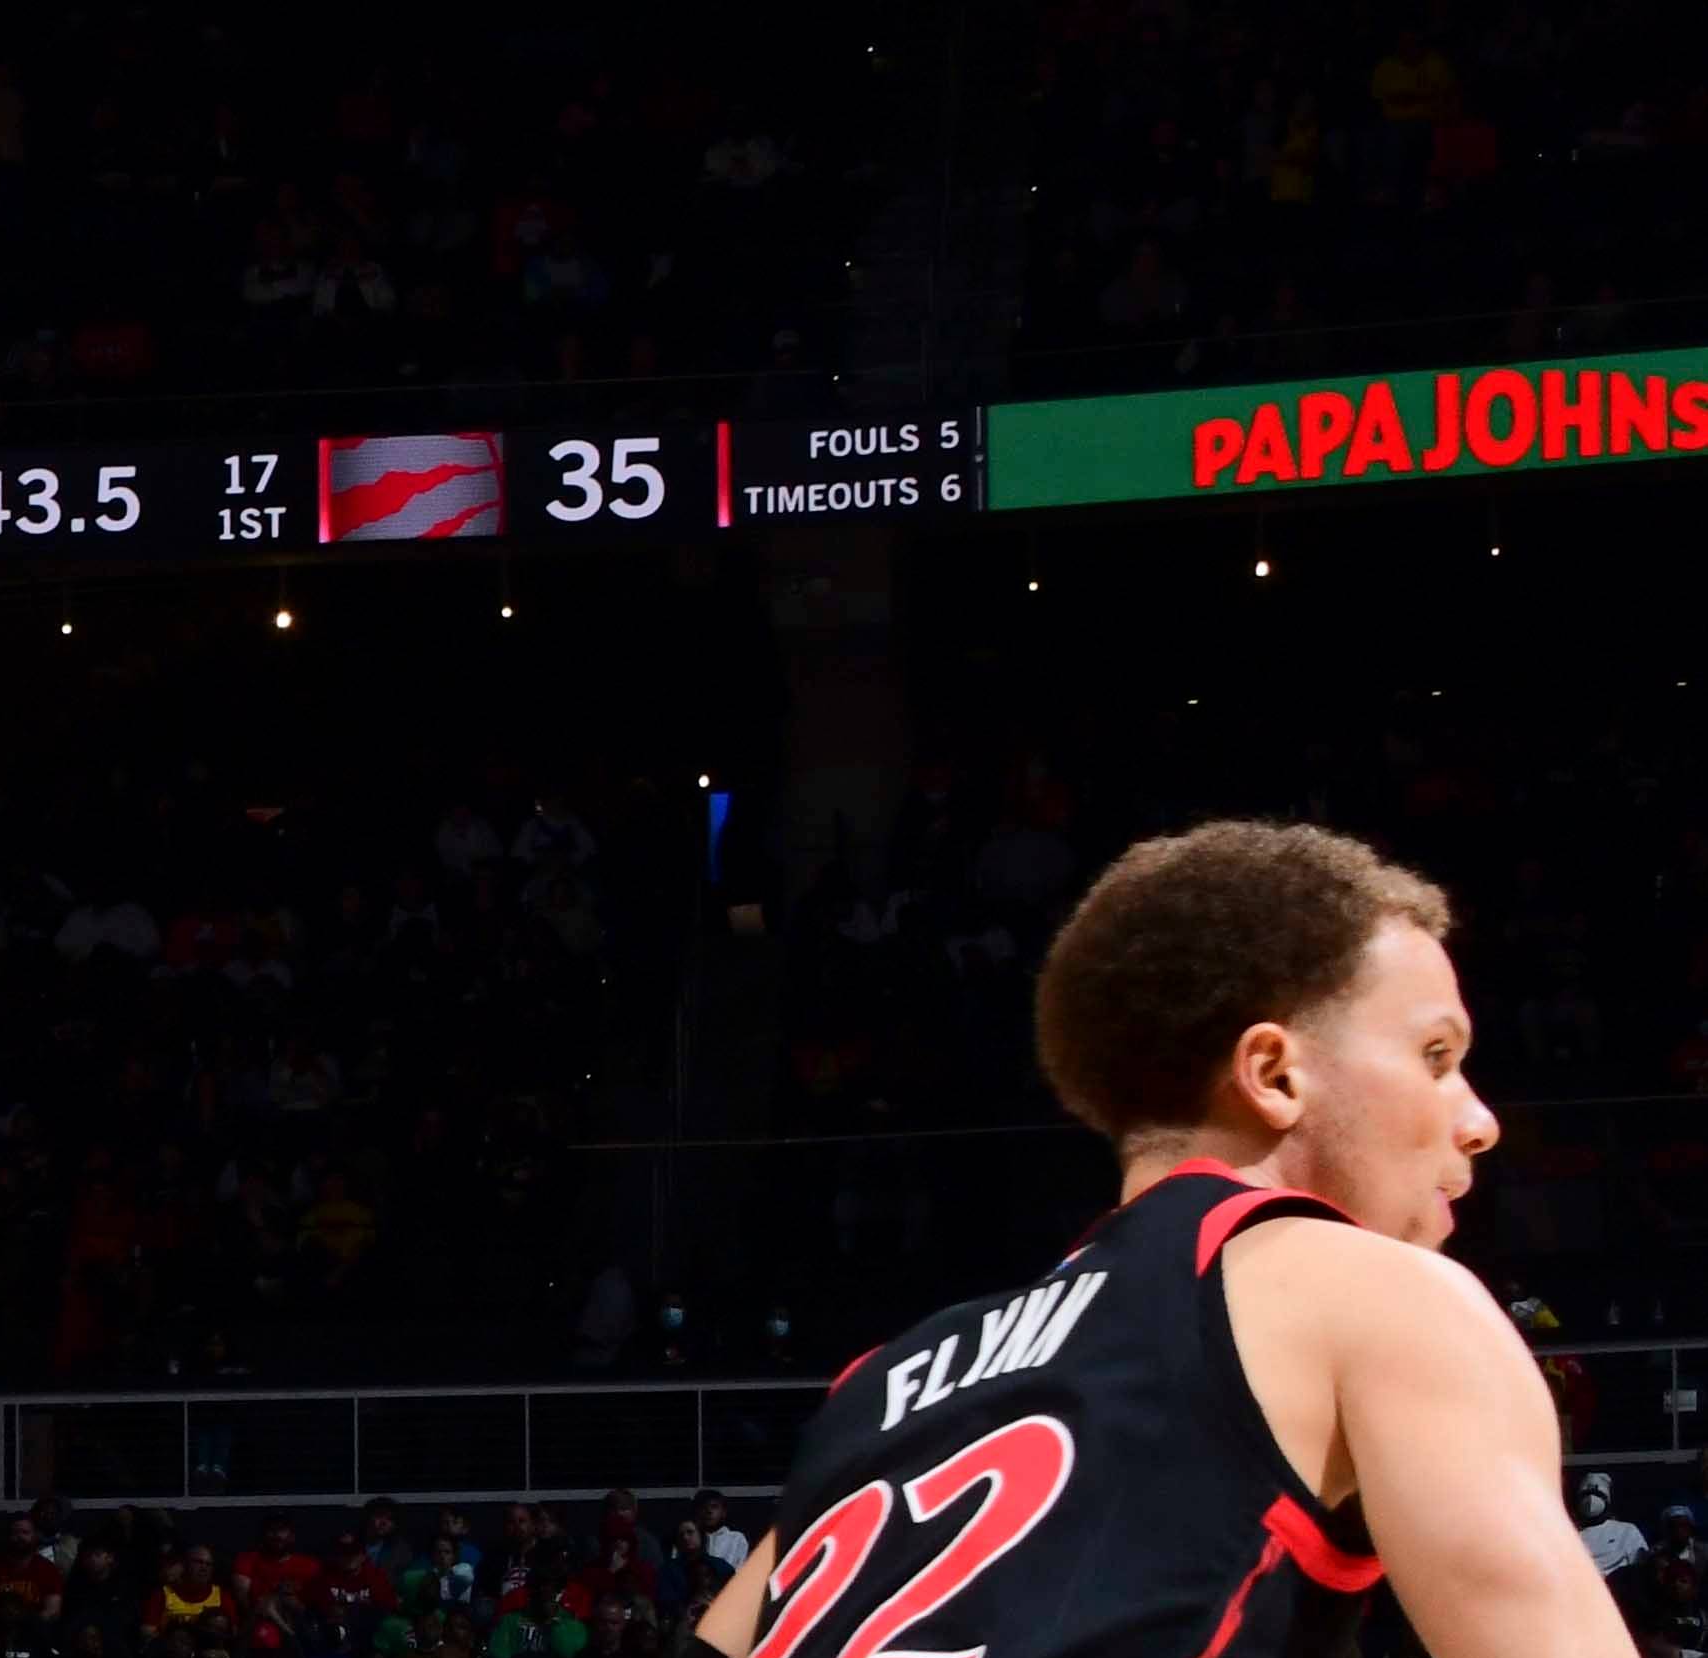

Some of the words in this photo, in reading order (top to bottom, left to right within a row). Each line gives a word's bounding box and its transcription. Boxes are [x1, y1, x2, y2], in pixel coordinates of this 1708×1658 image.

[809, 423, 921, 460] FOULS
[939, 420, 961, 449] 5
[1193, 381, 1414, 488] PAPA
[1422, 368, 1708, 472] JOHNS
[223, 453, 279, 495] 17
[544, 436, 666, 523] 35
[743, 476, 920, 515] TIMEOUTS
[940, 473, 962, 502] 6
[218, 506, 287, 541] 1ST
[880, 1270, 1108, 1431] FLYNN
